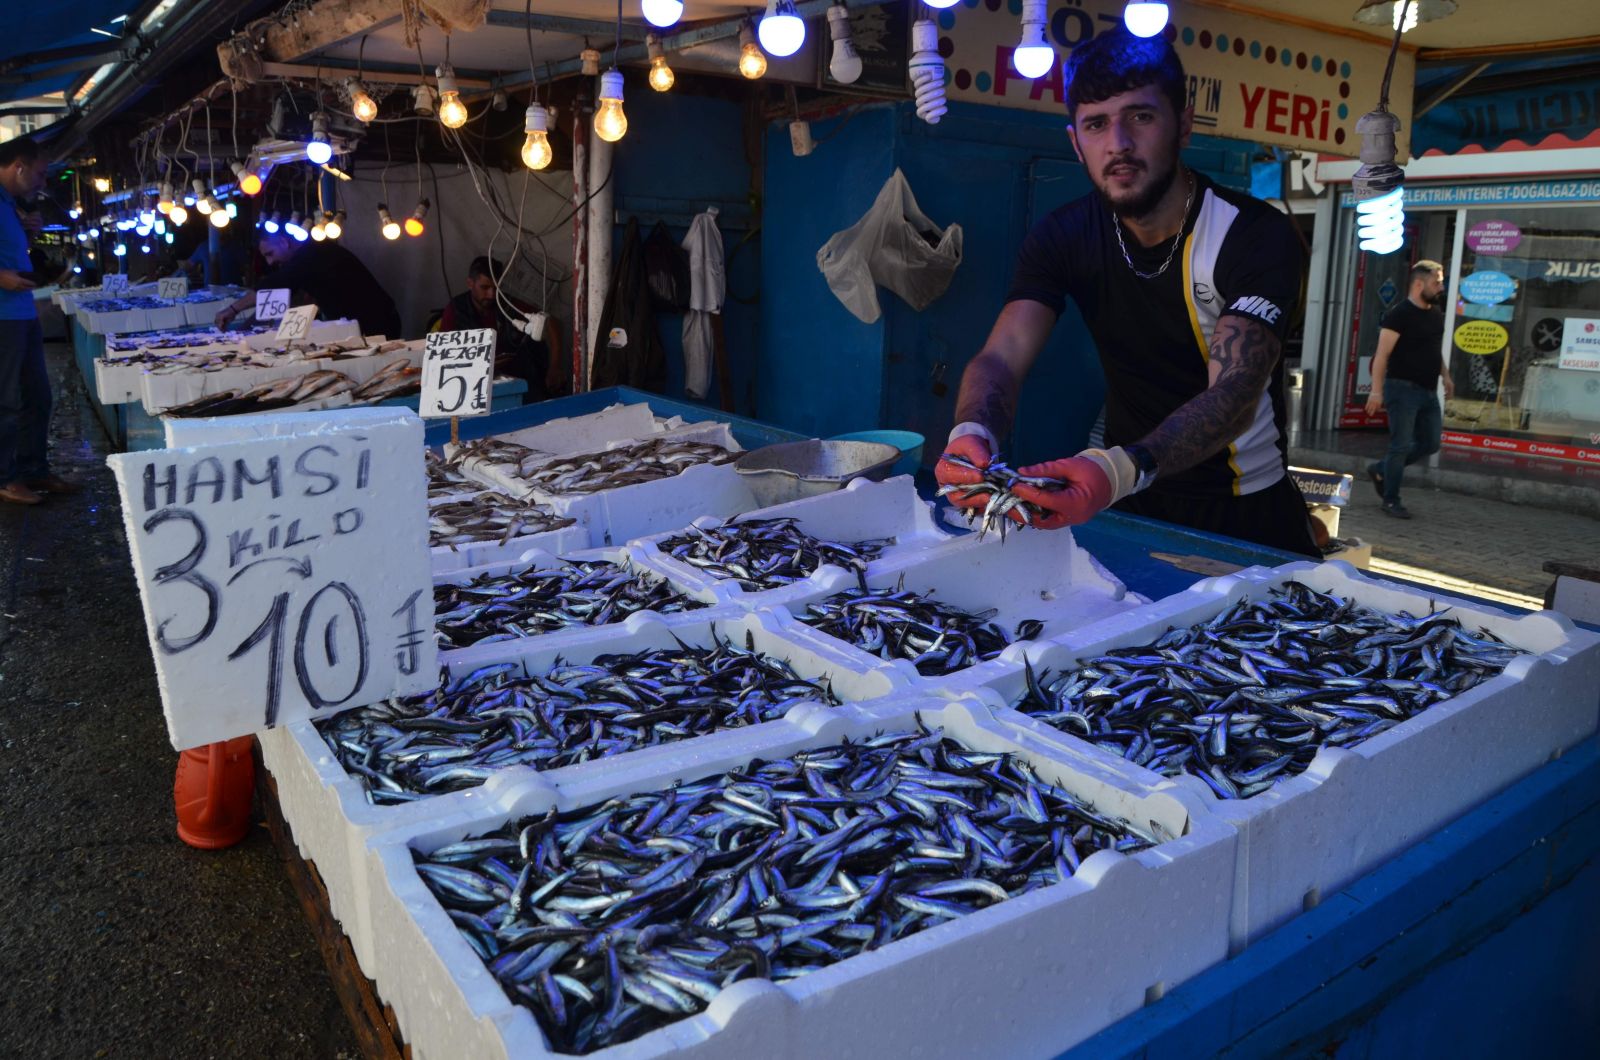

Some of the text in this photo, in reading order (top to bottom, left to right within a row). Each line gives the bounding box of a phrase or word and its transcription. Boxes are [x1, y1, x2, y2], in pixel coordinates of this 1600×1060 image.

[1240, 82, 1331, 141] YERİ
[1229, 296, 1282, 325] NIKE
[143, 507, 221, 656] 3
